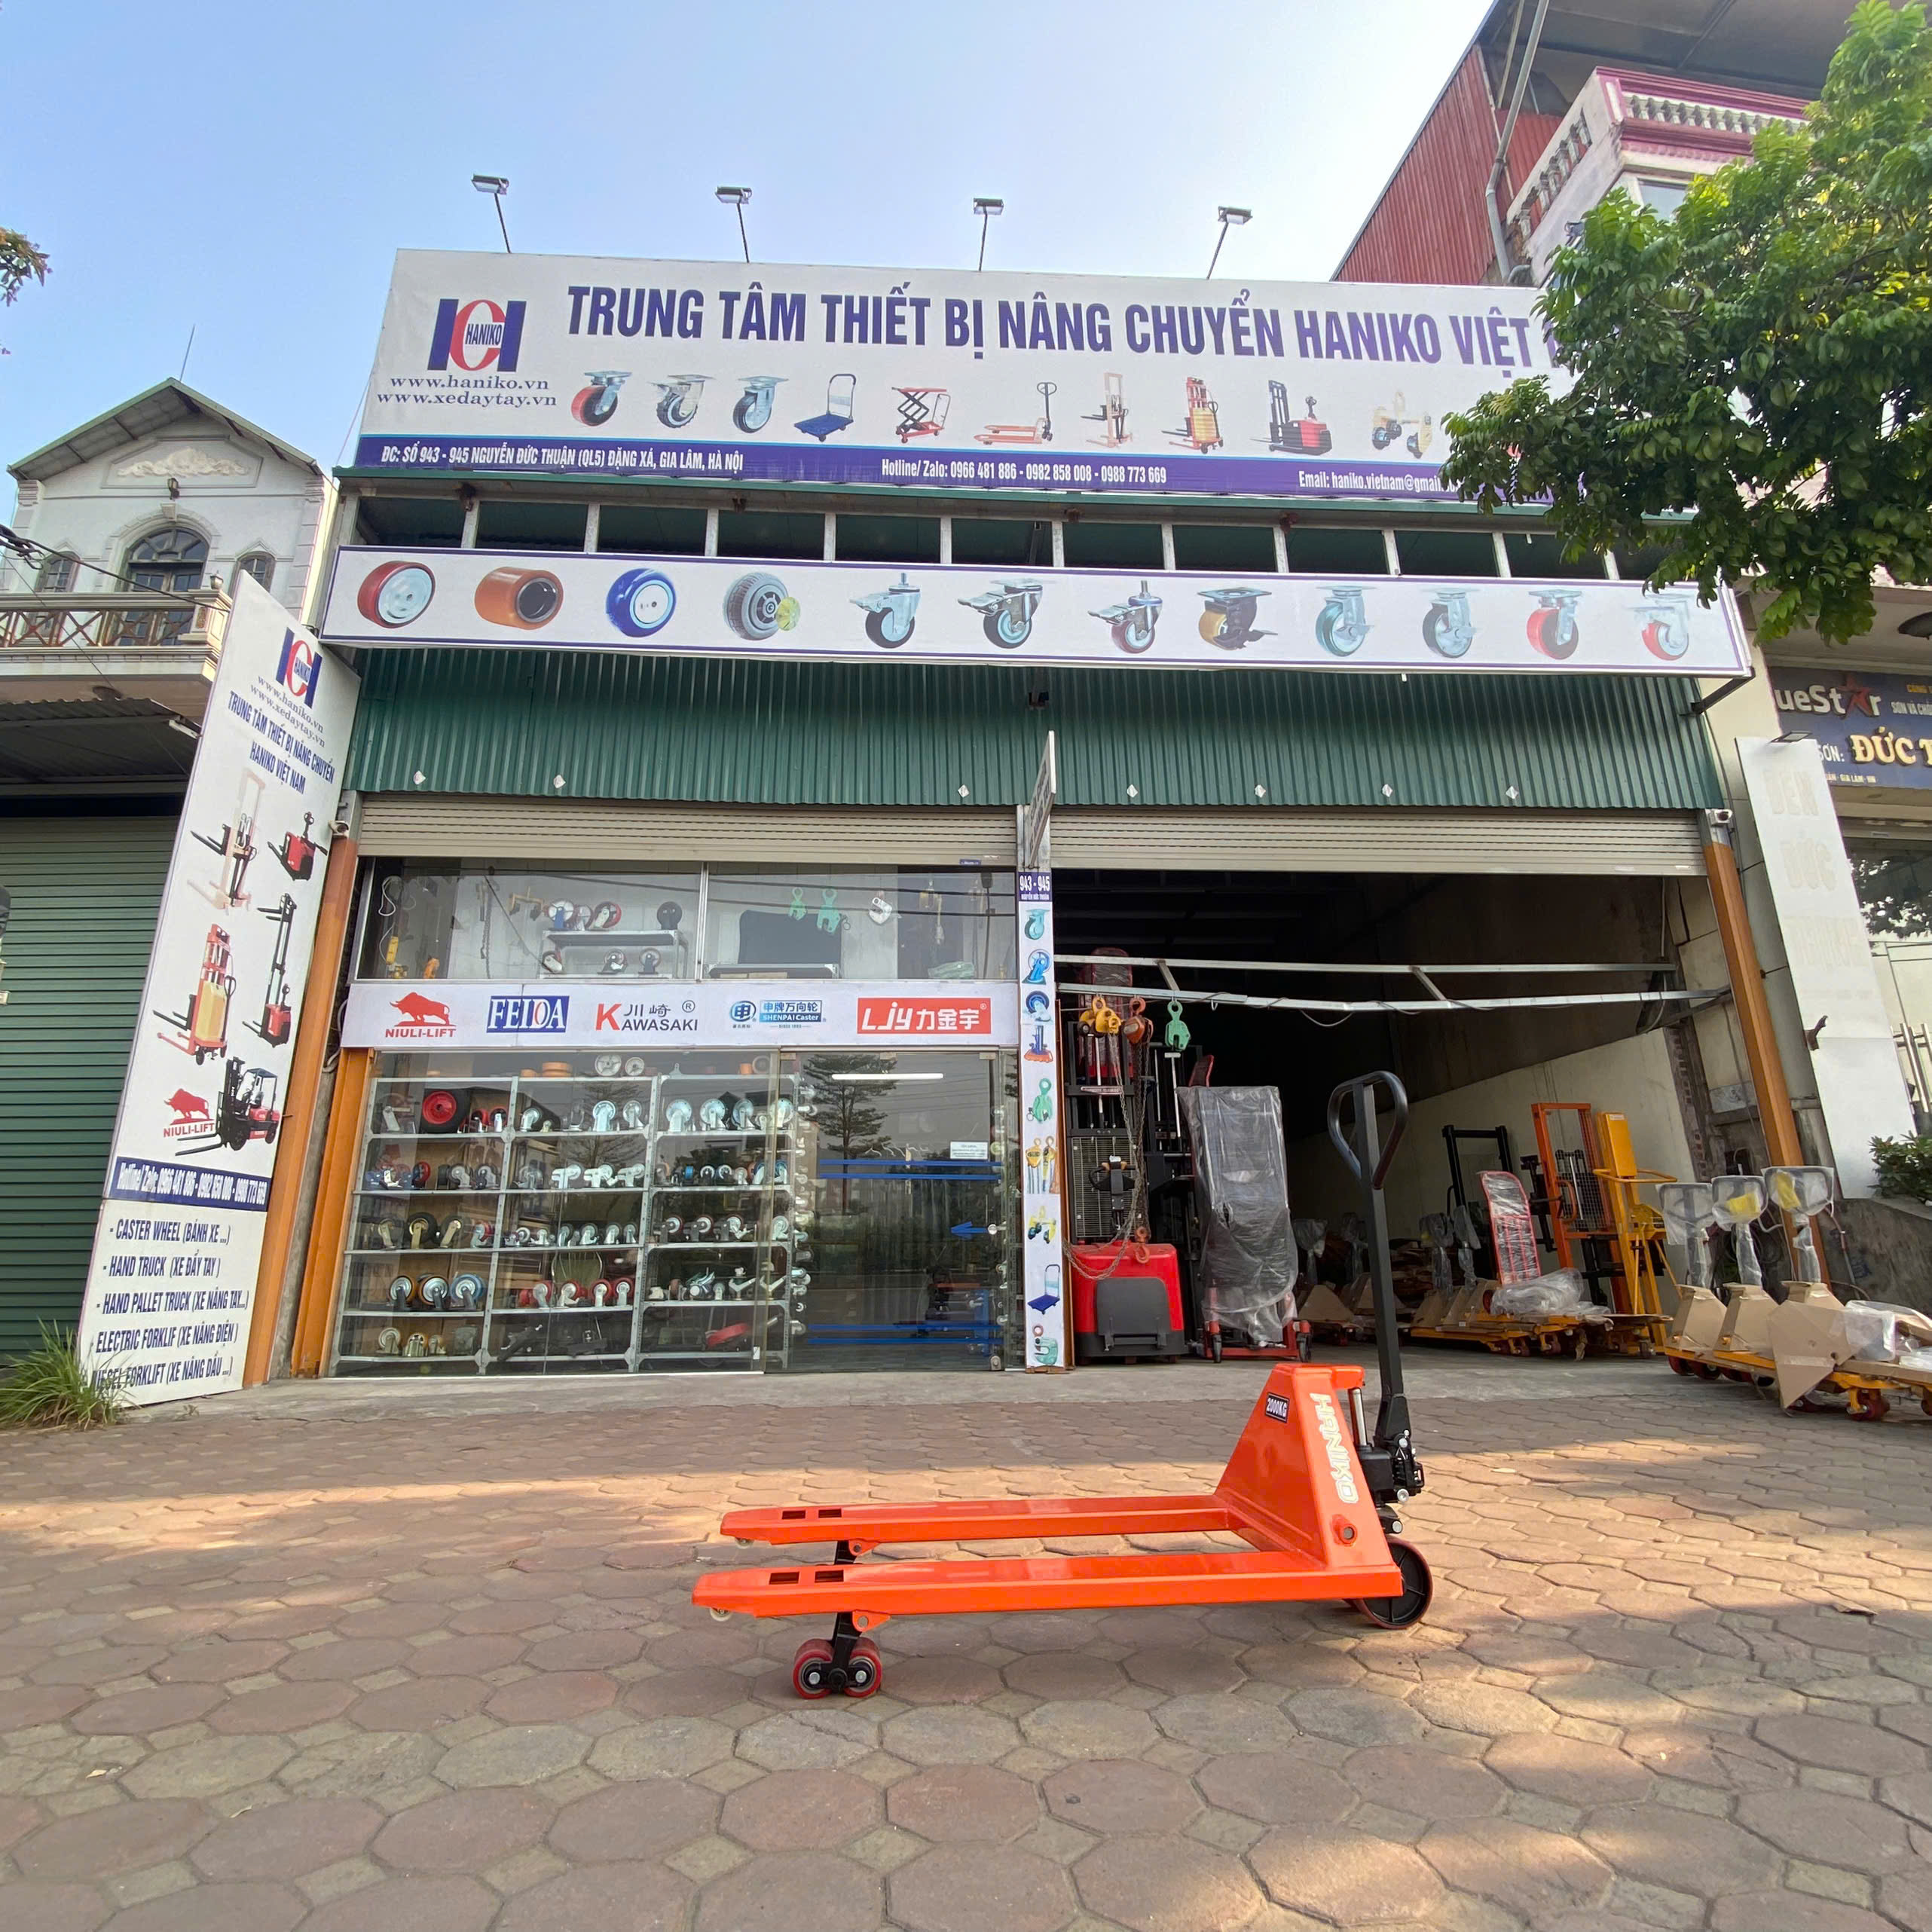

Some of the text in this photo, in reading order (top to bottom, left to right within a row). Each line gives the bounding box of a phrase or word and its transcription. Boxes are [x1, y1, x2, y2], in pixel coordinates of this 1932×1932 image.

[465, 323, 503, 346] HANIKO
[567, 286, 705, 338] TRUNG
[718, 282, 807, 341] TÂM
[820, 282, 931, 345] THIẾT
[945, 298, 984, 359] BỊ
[998, 291, 1112, 352] NÂNG
[1125, 288, 1285, 357] CHUYỂN
[1294, 309, 1442, 364] HANIKO
[1448, 307, 1533, 378] VIỆT
[390, 375, 549, 390] www.haniko.vn
[377, 391, 557, 408] www.xedaytay.vn
[381, 445, 401, 463] ĐC:
[402, 440, 420, 463] SỐ
[419, 446, 439, 463] 943
[448, 446, 469, 464] 945
[470, 442, 514, 464] NGUYỄN
[515, 445, 539, 465] ĐỨC
[540, 445, 576, 468] THUẬN
[578, 449, 605, 467] (QL5)
[607, 446, 637, 470] ĐẶNG
[640, 448, 657, 469] XÁ,
[659, 451, 677, 469] GIA
[680, 448, 705, 471] LÂM,
[708, 449, 723, 470] HÀ
[725, 451, 744, 474] NỘI
[882, 458, 922, 477] Hotline/
[923, 460, 948, 478] Zalo:
[950, 461, 975, 478] 0966
[977, 462, 995, 479] 481
[998, 463, 1017, 480] 886
[1026, 463, 1050, 481] 0982
[1053, 464, 1071, 481] 858
[1073, 465, 1092, 481] 008
[1101, 466, 1125, 482] 0988
[1127, 466, 1146, 483] 773
[1148, 466, 1167, 484] 669
[1298, 470, 1330, 489] Email:
[250, 684, 326, 747] www.xedaytay.vn
[258, 676, 324, 734] www.haniko.vn
[228, 690, 335, 784] TRUNG TÂM THIẾT BỊ NÂNG CHUYỂN
[1849, 726, 1917, 764] ĐỨC
[249, 741, 306, 795] HANIKO VIỆT NAM
[1019, 875, 1032, 891] 943
[1038, 875, 1050, 892] 945
[488, 998, 566, 1029] FEIDA
[763, 1001, 818, 1013] 申牌万向轮
[385, 1028, 457, 1038] NIULI-LIFT
[163, 1123, 216, 1137] NIULI-LIFT
[116, 1218, 151, 1240] CASTER
[152, 1220, 181, 1241] WHEEL
[182, 1218, 209, 1243] (BÁNH
[208, 1224, 220, 1243] XE
[109, 1255, 136, 1277] HAND
[138, 1256, 167, 1277] TRUCK
[170, 1257, 184, 1278] (XE
[102, 1293, 130, 1315] HAND
[130, 1292, 164, 1313] PALLET
[164, 1291, 191, 1312] TRUCK
[191, 1291, 207, 1313] (XE
[208, 1286, 228, 1310] NÂNG
[96, 1328, 142, 1353] ELECTRIC
[141, 1326, 177, 1350] FORKLIF
[177, 1325, 192, 1348] (XE
[192, 1320, 214, 1345] NÂNG
[216, 1319, 234, 1347] ĐIỆN
[125, 1362, 166, 1388] FORKLIFT
[166, 1361, 181, 1385] (XE
[182, 1356, 206, 1380] NÂNG
[1267, 1397, 1288, 1417] 2000KG
[1310, 1392, 1359, 1504] HANIKO
